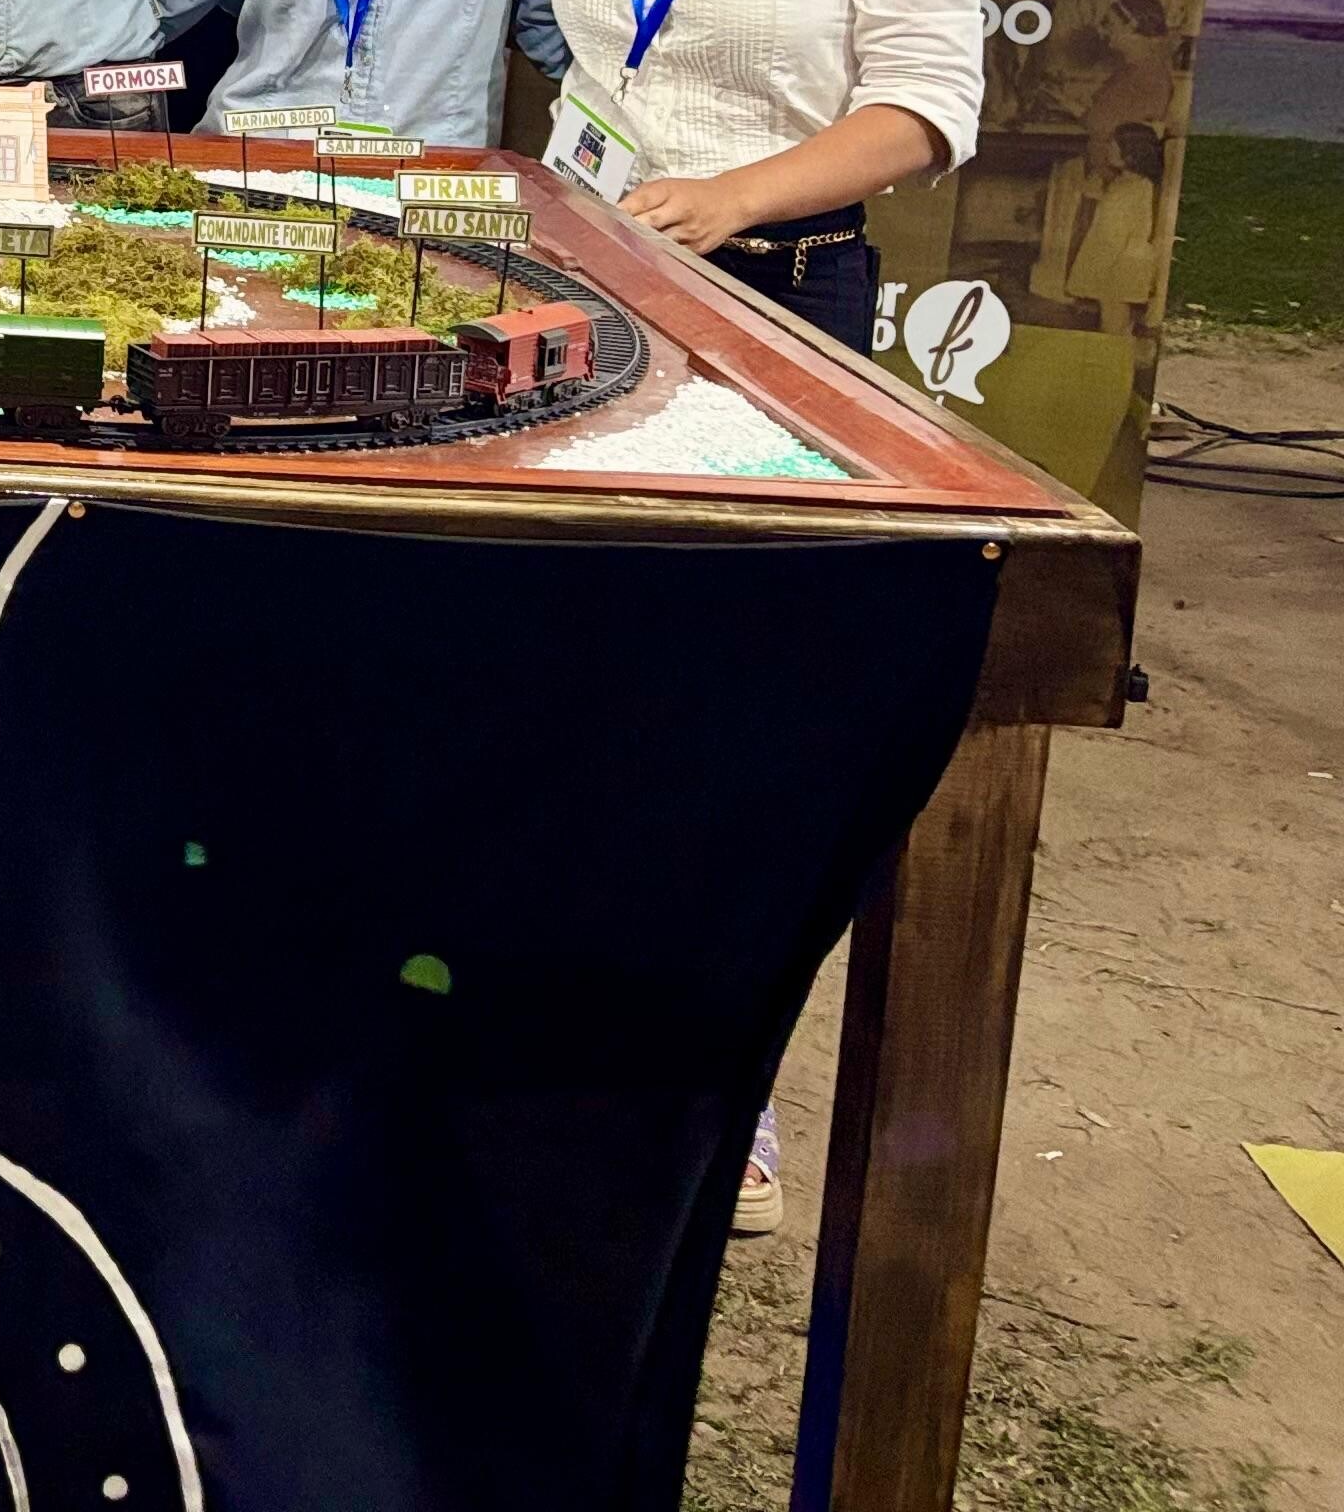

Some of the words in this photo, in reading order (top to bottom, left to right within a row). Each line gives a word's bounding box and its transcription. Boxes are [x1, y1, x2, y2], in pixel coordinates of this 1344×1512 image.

[90, 67, 179, 91] FORMOSA
[232, 112, 286, 128] MARIANO
[291, 109, 330, 124] BOEDO
[326, 139, 354, 153] SAN
[359, 139, 414, 154] HILARIO
[199, 218, 279, 245] COMANDANTE
[283, 224, 333, 248] FONTANA
[407, 208, 458, 233] PALO
[462, 211, 526, 238] SANTO
